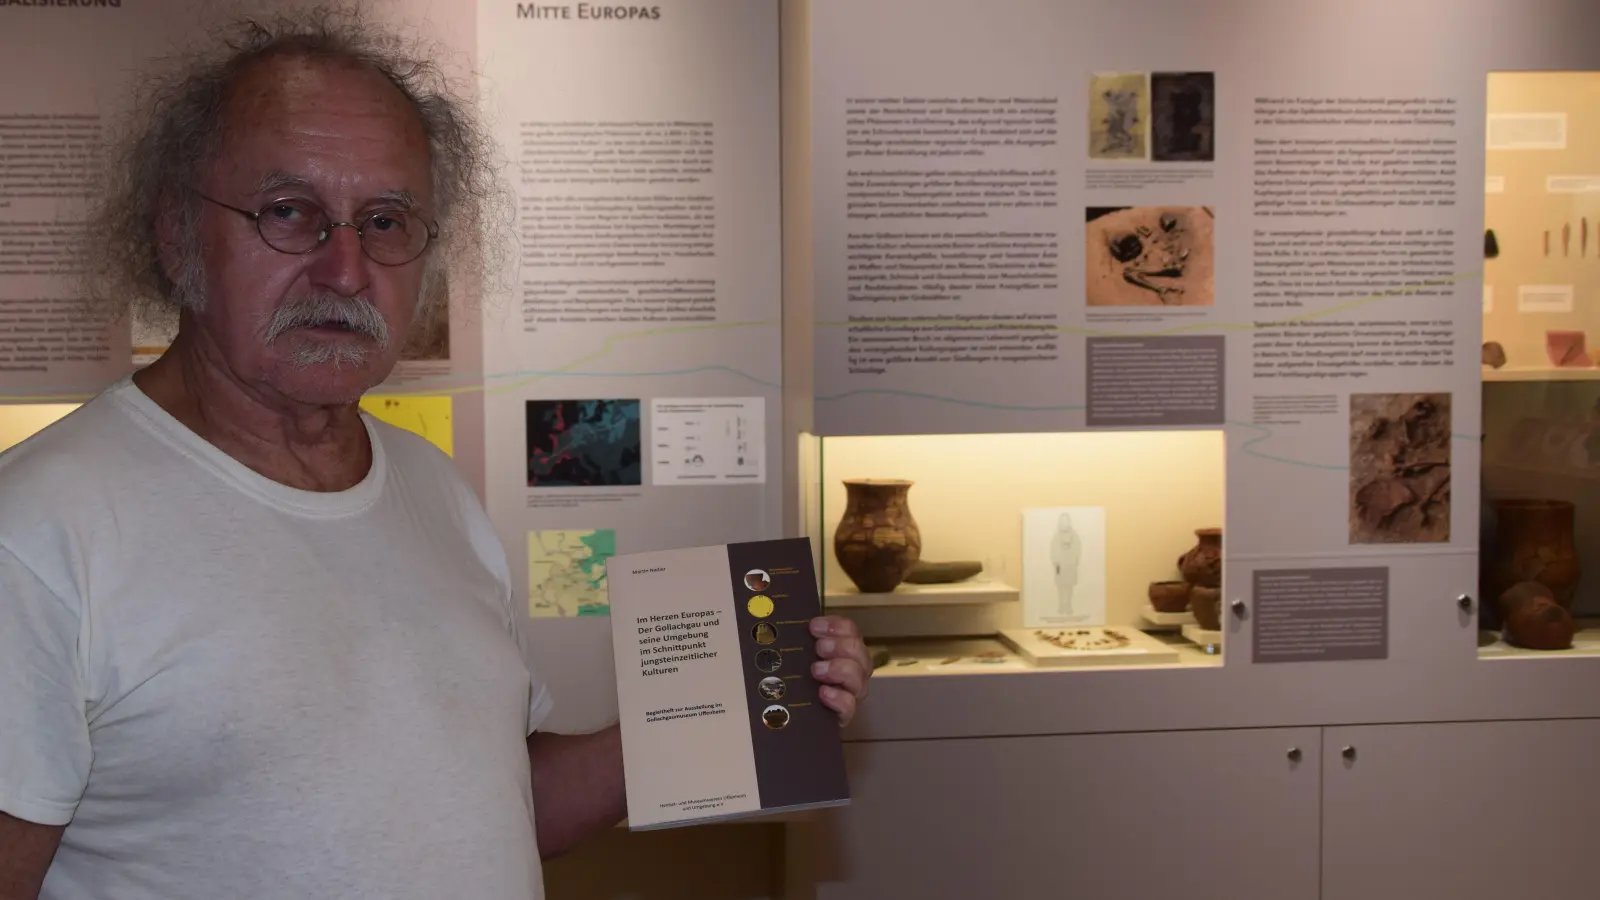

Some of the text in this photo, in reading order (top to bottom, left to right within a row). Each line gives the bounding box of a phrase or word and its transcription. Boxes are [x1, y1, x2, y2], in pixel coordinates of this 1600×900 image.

[636, 616, 648, 624] Im
[650, 613, 679, 623] Herzen
[681, 610, 715, 620] Europas
[638, 618, 720, 635] Der Gollachgau und
[638, 630, 709, 645] seine Umgebung
[640, 641, 707, 656] im Schnittpunkt
[640, 651, 718, 667] jungsteinzeitlicher
[642, 666, 679, 677] Kulturen
[645, 707, 674, 717] Begleitheft
[684, 703, 715, 712] Ausstellung
